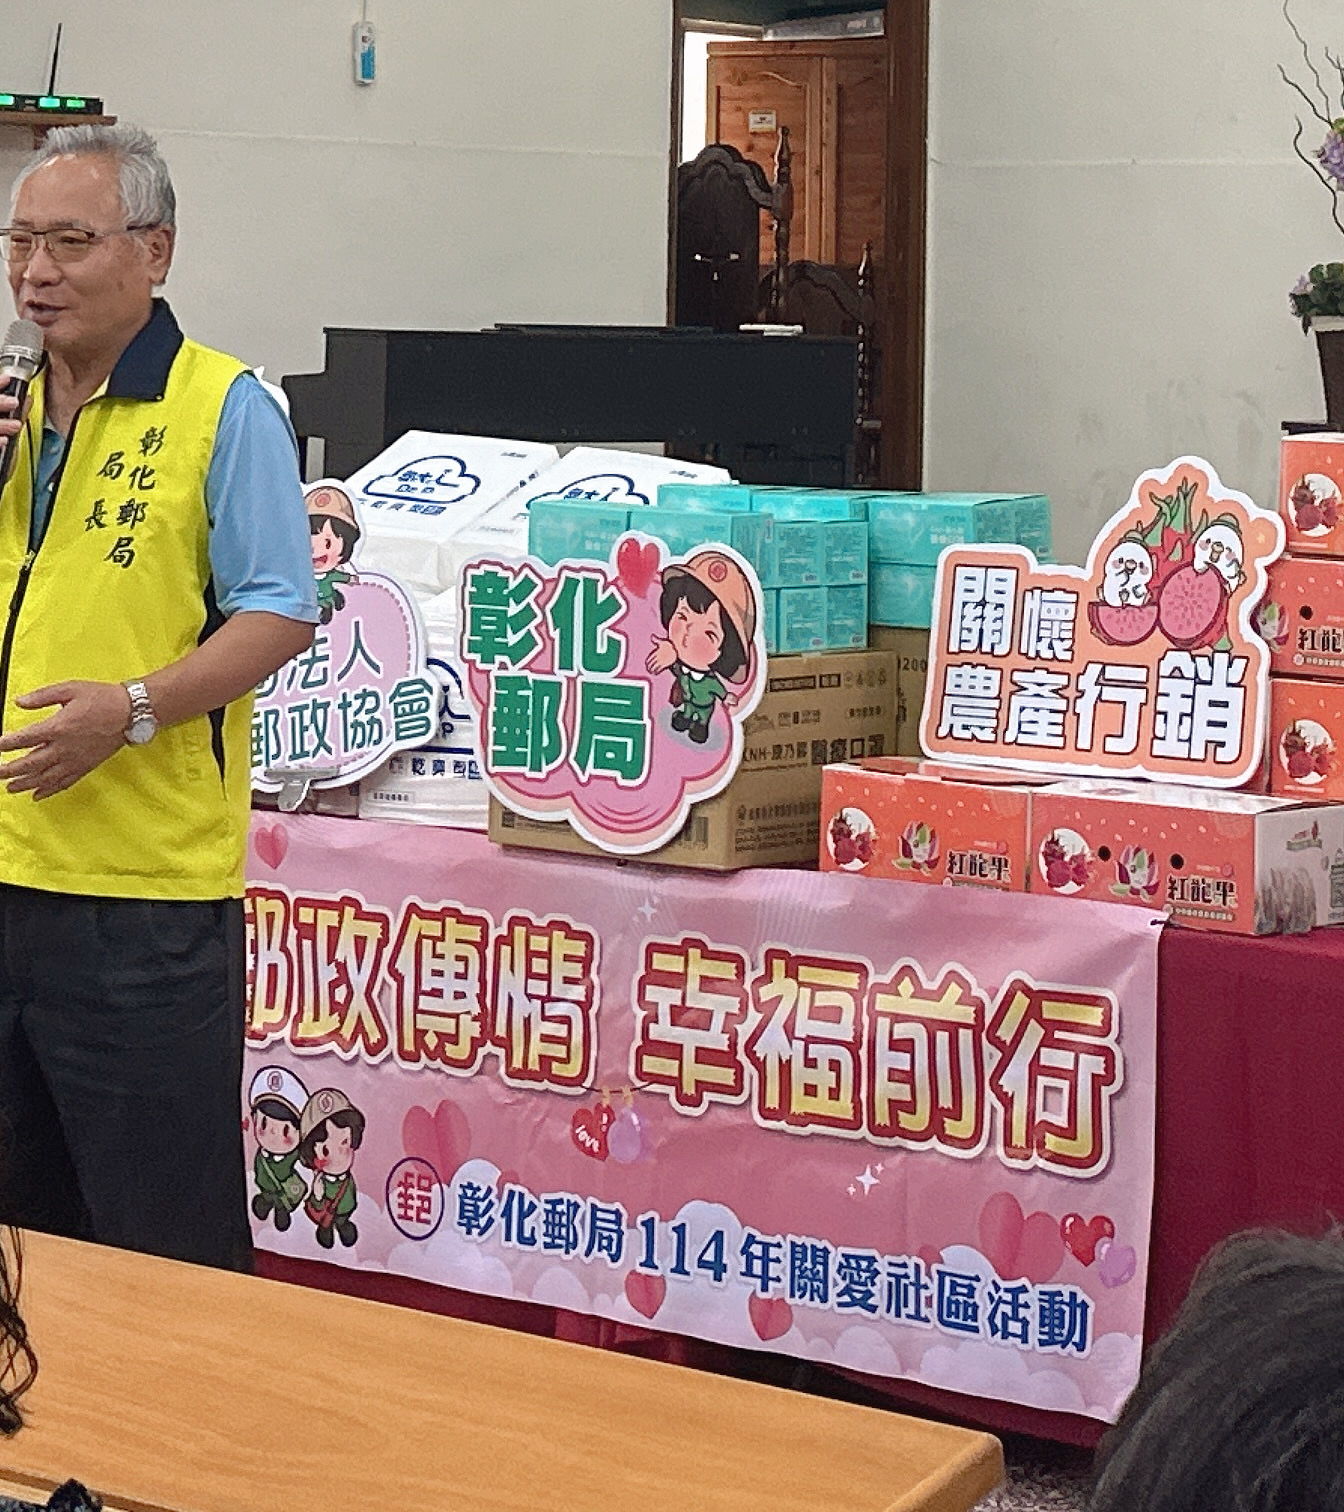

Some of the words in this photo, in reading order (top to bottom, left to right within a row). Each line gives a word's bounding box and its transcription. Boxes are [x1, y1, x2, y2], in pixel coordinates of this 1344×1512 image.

[84, 450, 125, 532] 局長
[103, 424, 168, 570] 彰化郵局
[256, 621, 382, 698] 法人
[467, 569, 628, 674] 彰化
[948, 565, 1080, 663] 關懷
[490, 678, 649, 783] 郵局
[936, 650, 1250, 764] 農產行銷
[640, 943, 1109, 1163] 幸福前行
[455, 1180, 1091, 1354] 彰化郵局114年關愛社區活動
